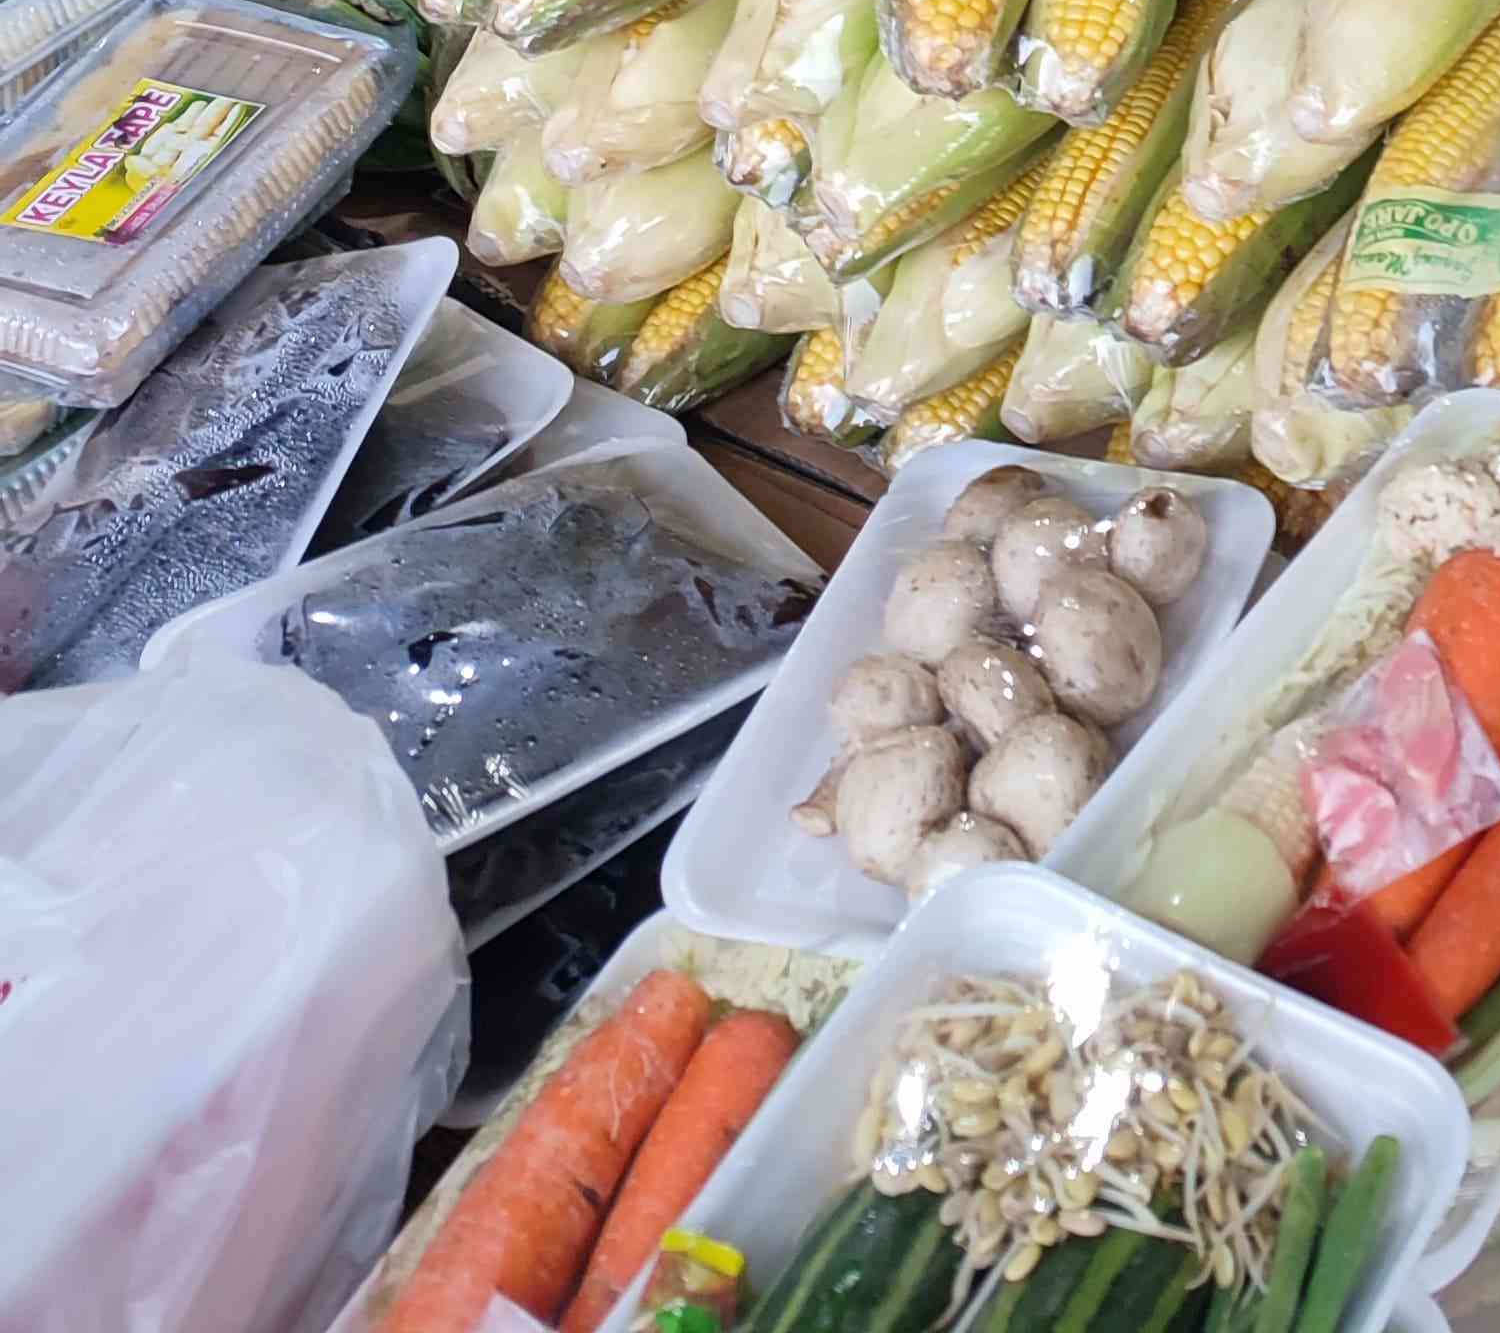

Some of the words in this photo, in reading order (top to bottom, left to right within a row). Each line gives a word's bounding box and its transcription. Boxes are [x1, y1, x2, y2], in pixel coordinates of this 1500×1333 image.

[19, 151, 121, 224] KEYLA
[97, 89, 179, 149] TAPE
[1424, 213, 1479, 244] OPO
